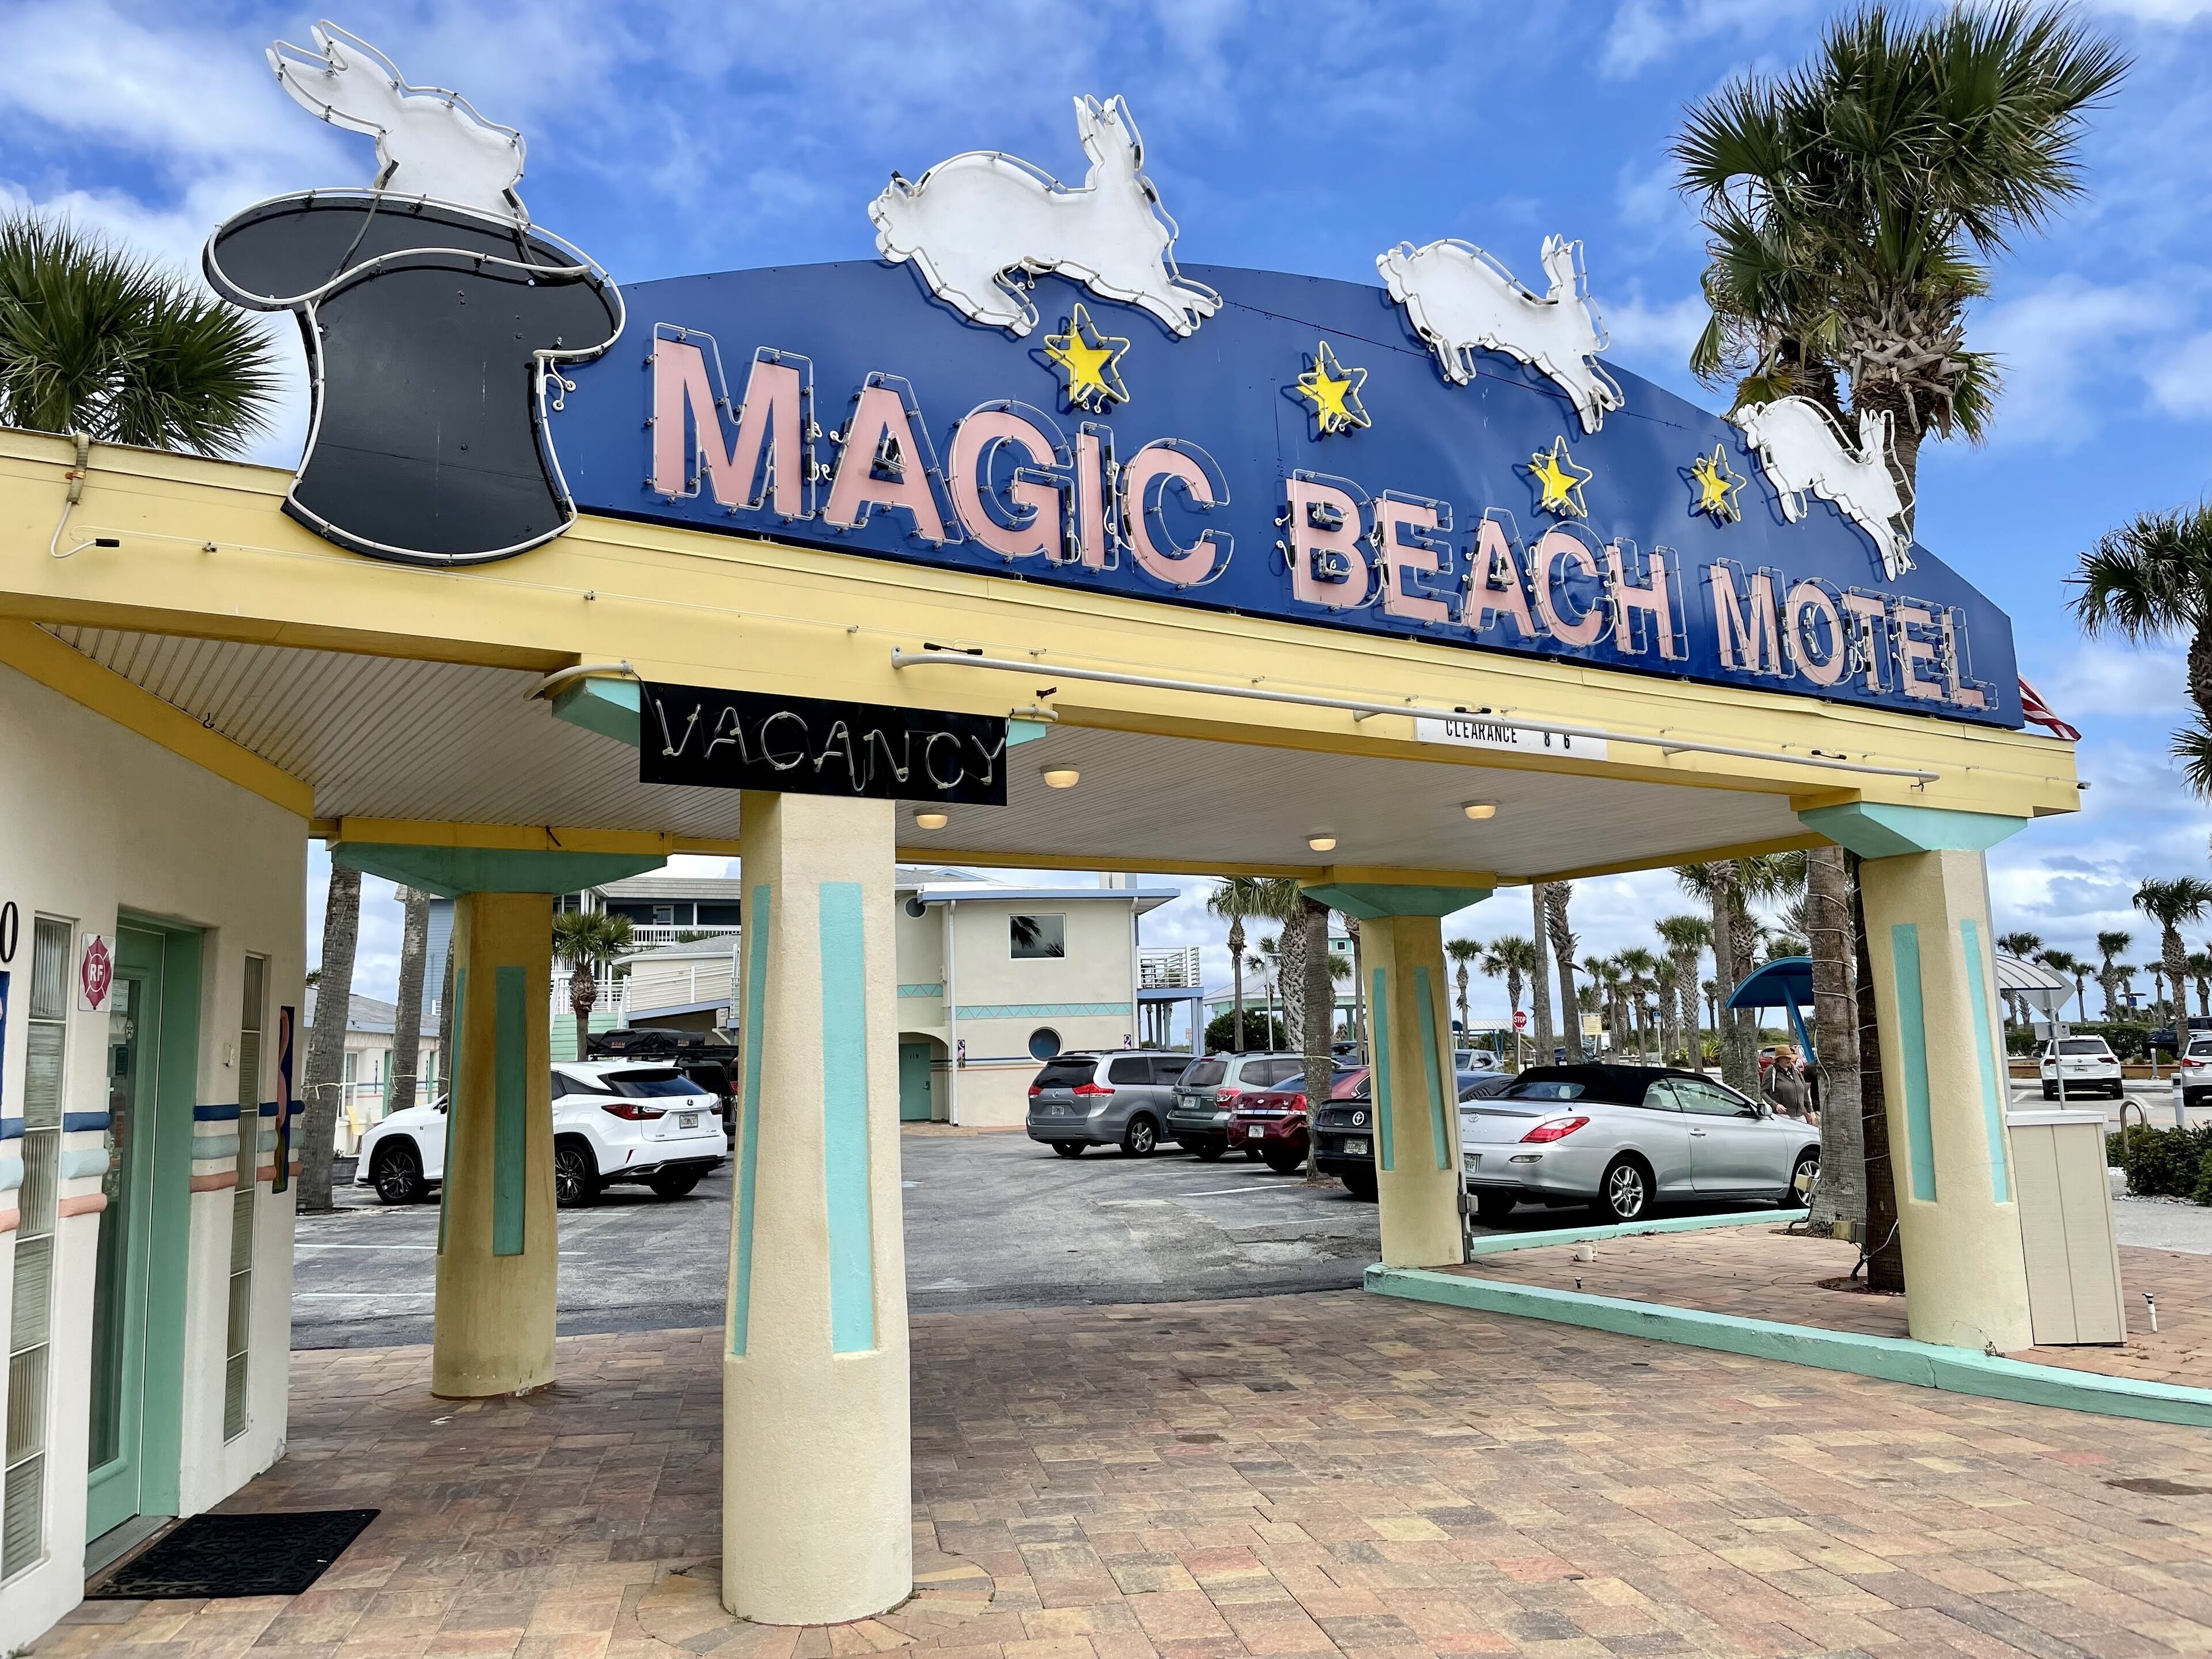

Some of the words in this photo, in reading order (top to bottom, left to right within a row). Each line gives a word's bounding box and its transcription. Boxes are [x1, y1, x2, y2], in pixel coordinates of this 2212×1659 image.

[652, 323, 1234, 588] MAGIC
[1285, 469, 1689, 661] BEACH
[1709, 557, 1999, 711] MOTEL
[655, 698, 1006, 791] VACANCY
[1446, 721, 1517, 744] CLEARANCE
[1544, 732, 1551, 747] 8
[1563, 734, 1570, 749] 6
[89, 963, 104, 982] RF
